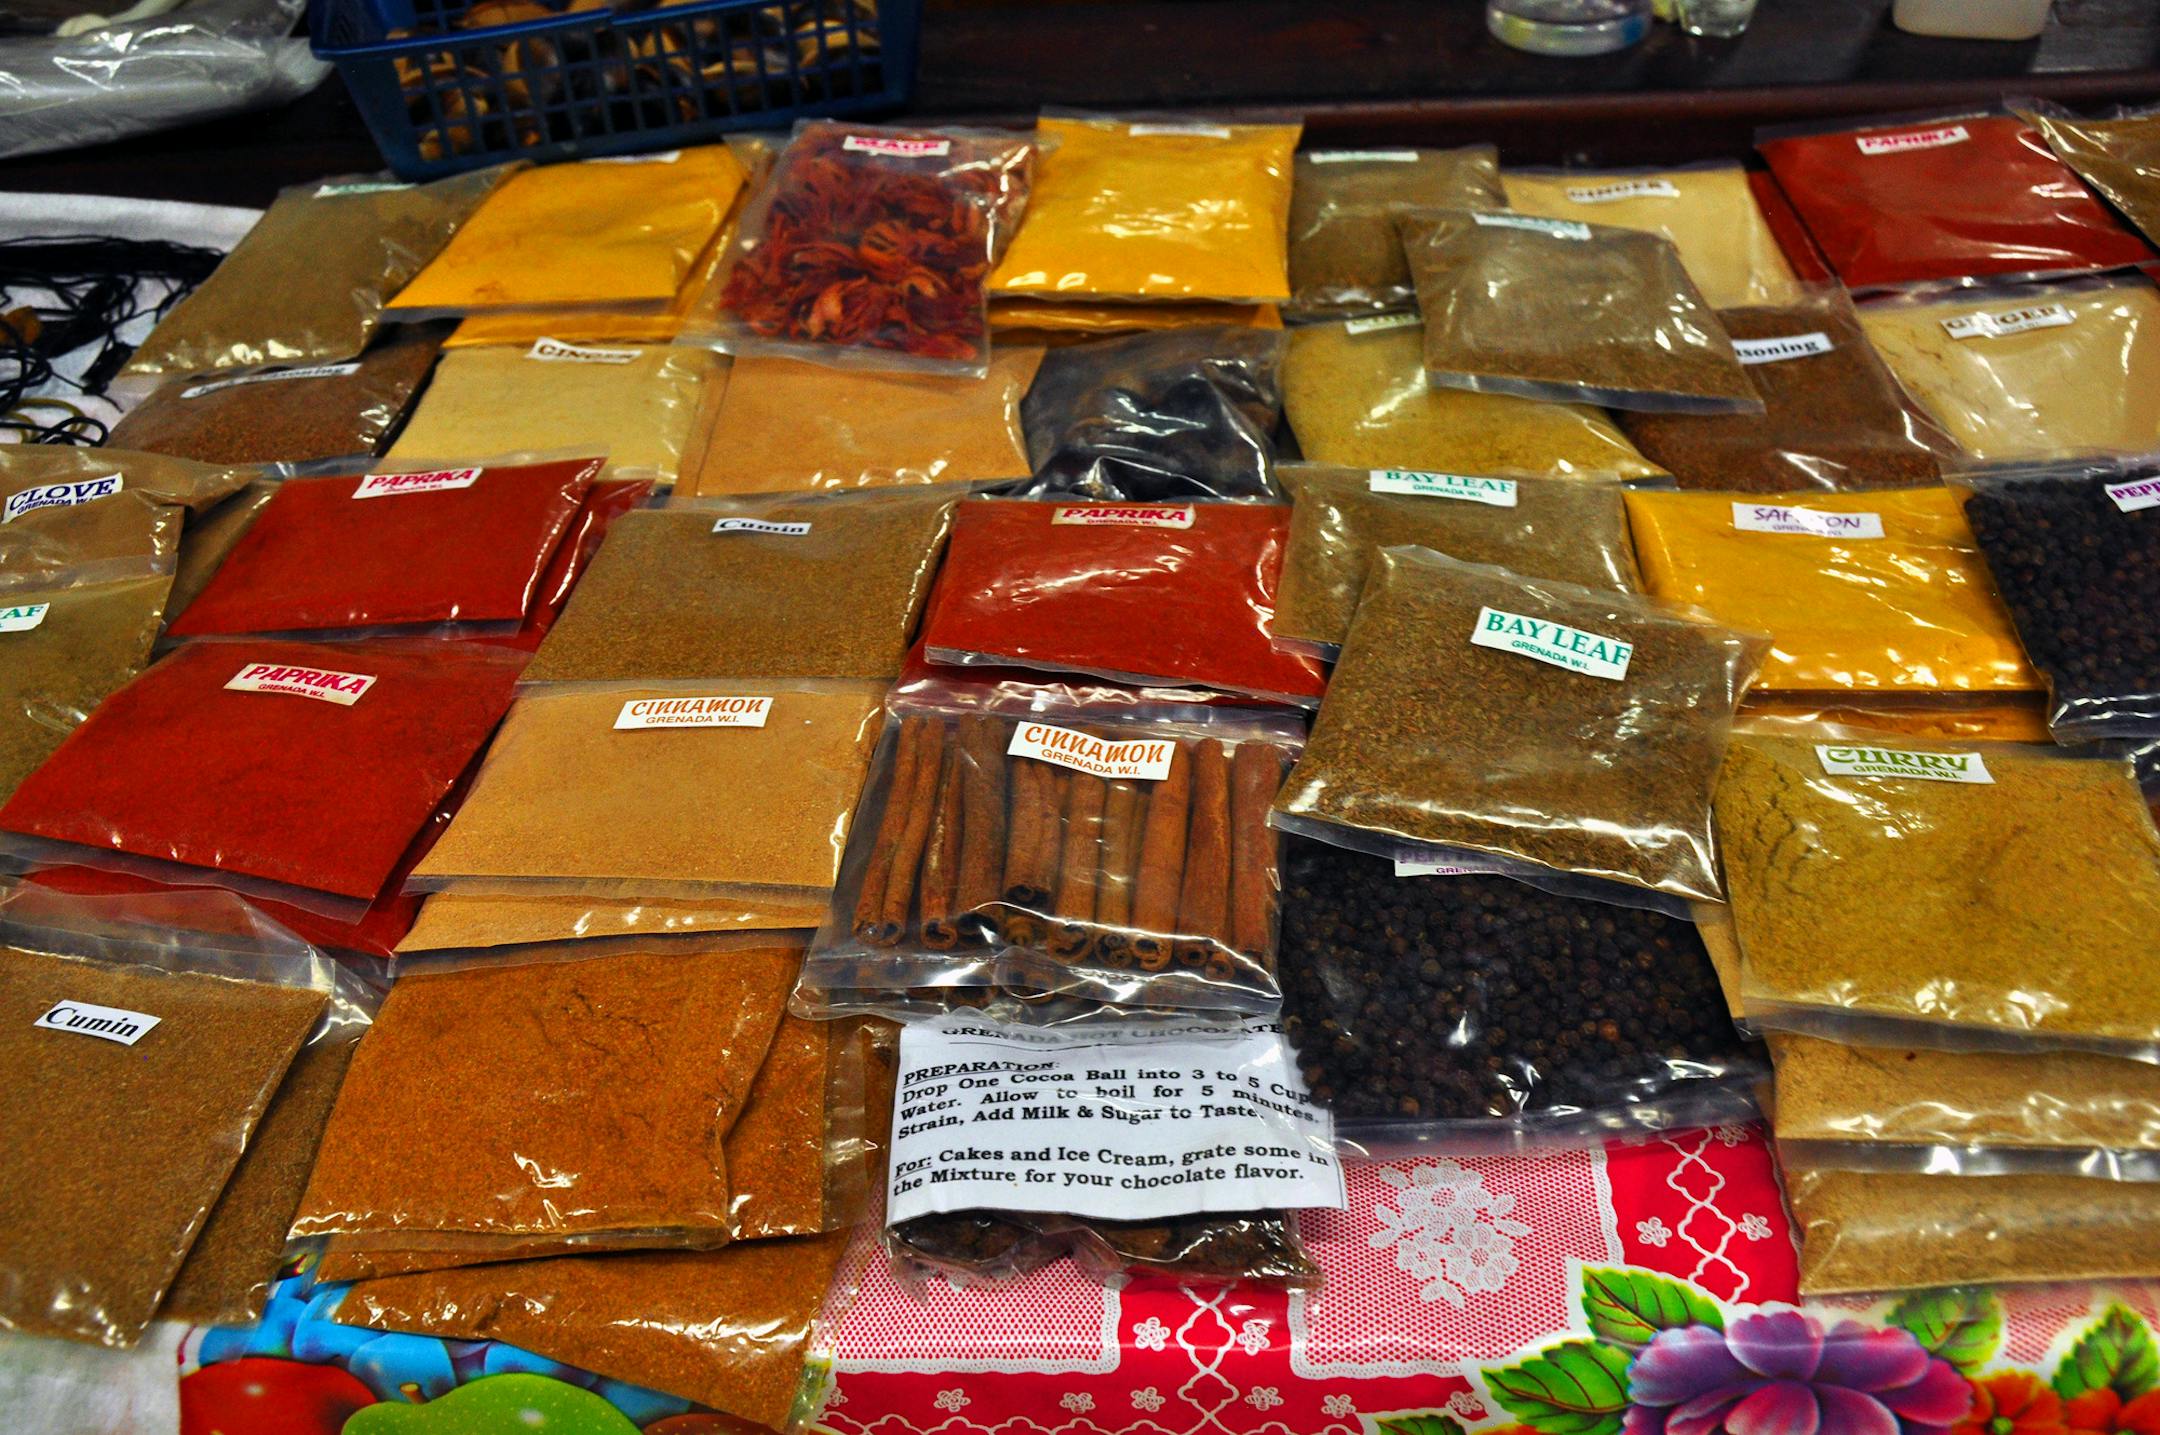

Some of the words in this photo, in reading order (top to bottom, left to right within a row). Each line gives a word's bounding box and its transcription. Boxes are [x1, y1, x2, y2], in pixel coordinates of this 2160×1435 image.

[367, 469, 474, 489] PAPRIKA
[1385, 471, 1438, 483] BAY
[1447, 475, 1514, 493] LEAF
[1413, 484, 1465, 496] GRENADA
[9, 478, 116, 511] CLOVE
[17, 498, 72, 515] GRENADA
[720, 520, 804, 533] Cumin
[1062, 509, 1186, 522] PAPRIKA
[1754, 507, 1861, 528] SAFON
[1486, 612, 1548, 640] BAY
[1551, 627, 1632, 666] LEAF
[1511, 640, 1568, 664] GRENADA
[243, 665, 368, 695] PAPRIKA
[258, 683, 307, 694] GRENADA
[631, 698, 765, 716] CINNAMON
[646, 715, 713, 724] GRENADA
[717, 715, 740, 723] W.I.
[1024, 725, 1166, 764] CINNAMON
[1041, 748, 1113, 775] GRENADA
[1118, 765, 1141, 775] W.I.
[1853, 765, 1932, 778] GRENADA
[46, 1007, 139, 1037] Cumin
[1132, 1023, 1285, 1039] CHOCOATE
[903, 1061, 1061, 1087] PREPARATION:
[902, 1083, 947, 1105] Drop
[958, 1077, 1000, 1090] One
[1010, 1071, 1074, 1084] Cocoa
[1086, 1069, 1127, 1081] Ball
[1137, 1068, 1181, 1080] into
[1192, 1069, 1205, 1080] 3
[1216, 1070, 1238, 1082] to
[1248, 1076, 1260, 1089] 5
[900, 1097, 962, 1121] Water.
[980, 1090, 1040, 1104] Allow
[1056, 1088, 1079, 1099] to
[1095, 1084, 1136, 1099] boil
[1153, 1084, 1184, 1098] for
[1201, 1084, 1214, 1097] 5
[1232, 1088, 1319, 1124] minutes.
[898, 1115, 965, 1140] Strain,
[972, 1107, 1014, 1122] Add
[1021, 1105, 1070, 1120] Milk
[1077, 1105, 1094, 1119] &
[1101, 1105, 1163, 1125] Sugar
[1169, 1105, 1192, 1119] to
[1200, 1104, 1265, 1120] Taste.
[895, 1155, 932, 1180] For:
[938, 1147, 1004, 1163] Cakes
[1010, 1147, 1051, 1162] and
[1057, 1146, 1090, 1162] Ice
[1097, 1149, 1174, 1168] Cream,
[1181, 1144, 1237, 1166] grate
[1243, 1144, 1301, 1159] some
[1308, 1151, 1329, 1167] in
[893, 1177, 923, 1197] the
[929, 1167, 1017, 1184] Mixture
[1024, 1168, 1056, 1183] for
[1063, 1171, 1114, 1187] your
[1120, 1166, 1226, 1190] chocolate
[1234, 1163, 1304, 1180] flavor.
